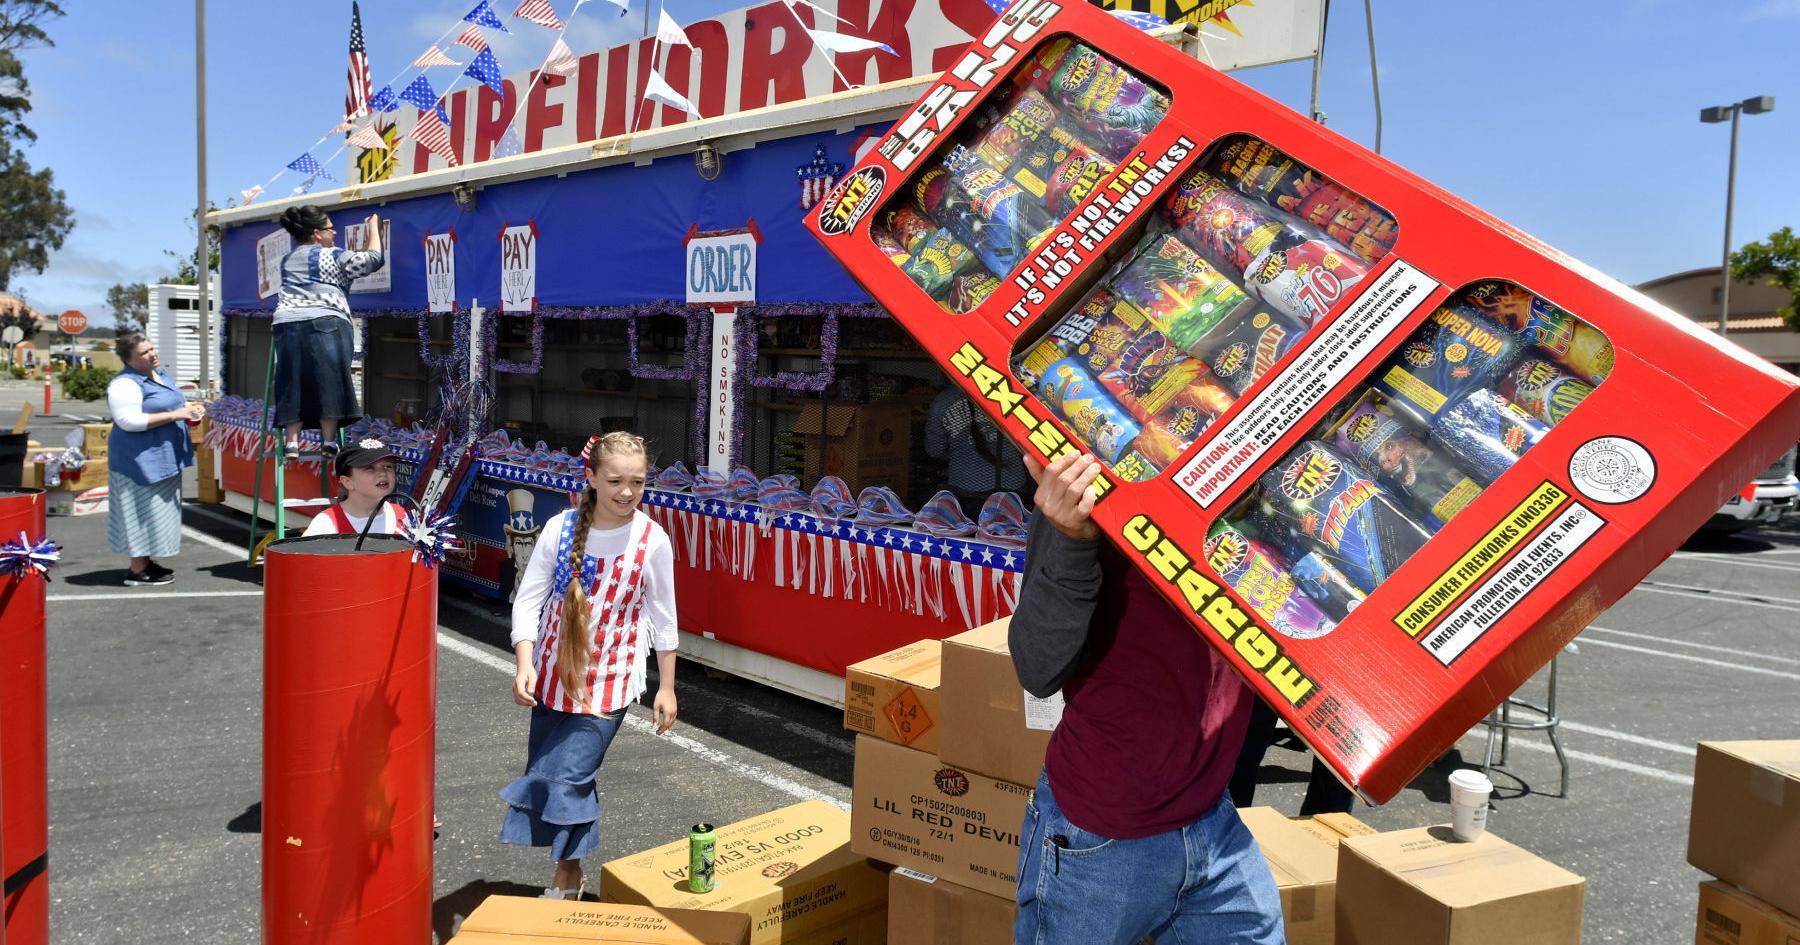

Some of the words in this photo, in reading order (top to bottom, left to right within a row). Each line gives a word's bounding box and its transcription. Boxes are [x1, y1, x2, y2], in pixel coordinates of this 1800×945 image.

[895, 0, 1042, 144] BIG
[1070, 56, 1089, 82] TNT
[890, 0, 1063, 178] BANG
[1069, 162, 1099, 205] RIP
[833, 178, 868, 223] TNT
[1003, 283, 1047, 328] IT'S
[1040, 246, 1084, 291] NOT
[1077, 132, 1197, 255] FIREWORKS!
[1013, 265, 1040, 292] IF
[1032, 228, 1077, 273] IT'S
[1069, 191, 1113, 236] NOT
[427, 238, 451, 274] PAY
[503, 233, 532, 269] PAY
[433, 272, 448, 289] HERE
[508, 270, 524, 287] HERE
[690, 243, 753, 293] ORDER
[1262, 254, 1280, 280] TNT
[1298, 265, 1342, 317] 76
[60, 316, 86, 328] STOP
[1435, 307, 1471, 338] SUPER
[1466, 328, 1504, 356] NOVA
[721, 335, 730, 358] NO
[1223, 347, 1242, 372] TNT
[1181, 439, 1234, 488] CAUTION:
[1224, 426, 1239, 440] This
[1237, 396, 1271, 428] assortment
[1269, 371, 1297, 398] contains
[1293, 355, 1313, 374] items
[1310, 343, 1326, 358] that
[1323, 331, 1339, 347] may
[1336, 322, 1347, 333] be
[1371, 290, 1379, 298] if
[1376, 264, 1407, 292] misused.
[1231, 432, 1245, 446] Use
[1242, 408, 1271, 435] outdoors
[1283, 382, 1298, 396] Use
[1295, 369, 1312, 385] only
[1309, 352, 1329, 372] under
[1326, 336, 1346, 355] close
[1343, 321, 1361, 338] adult
[1357, 285, 1399, 324] supervision.
[1194, 438, 1261, 500] IMPORTANT:
[1253, 415, 1280, 440] READ
[1278, 370, 1328, 416] CAUTIONS
[1325, 349, 1349, 371] AND
[1345, 282, 1419, 350] INSTRUCTIONS
[718, 366, 730, 455] SMOKING
[1177, 412, 1192, 433] TNT
[1260, 430, 1277, 446] ON
[1276, 405, 1303, 431] EACH
[1301, 382, 1327, 406] ITEM
[1354, 416, 1373, 437] TNT
[1295, 454, 1327, 494] TNT
[1208, 537, 1235, 573] TNT
[1519, 571, 1536, 588] CA
[1530, 546, 1564, 577] 92833
[1402, 574, 1463, 631] CONSUMER
[1455, 522, 1520, 582] FIREWORKS
[1428, 612, 1470, 651] AMERICAN
[1470, 557, 1532, 614] PROMOTIONAL
[1526, 527, 1566, 564] EVENTS,
[1122, 513, 1321, 709] CHARGE
[899, 702, 917, 720] 1.4
[901, 721, 911, 733] G
[941, 777, 962, 789] TNT
[874, 797, 902, 815] LIL
[911, 808, 954, 829] RED
[910, 794, 986, 825] CP1502[200803]
[722, 838, 750, 851] 18/2
[746, 838, 770, 855] VS
[775, 825, 824, 845] GOOD
[929, 828, 954, 843] 72/1
[969, 863, 988, 875] MADE
[990, 868, 997, 878] IN
[999, 871, 1016, 883] CHIN
[791, 892, 814, 906] FIRE
[809, 890, 847, 909] HANDLE
[813, 883, 838, 898] KEEP
[570, 911, 603, 919] AWAY
[754, 903, 811, 930] CAREFULLY
[764, 900, 792, 915] AWAY
[556, 917, 620, 928] CAREFULLY
[622, 923, 667, 931] HANDLE
